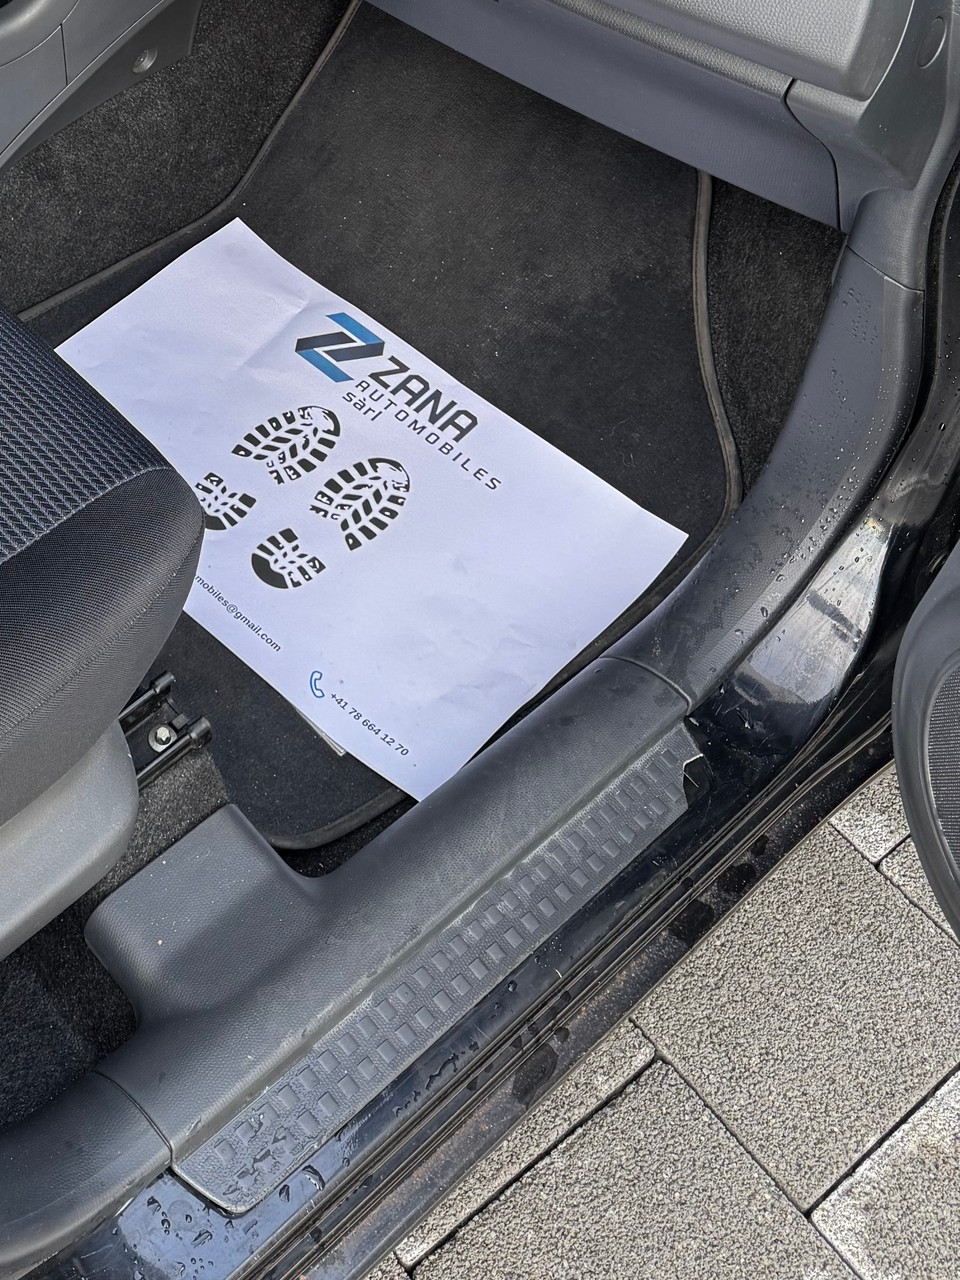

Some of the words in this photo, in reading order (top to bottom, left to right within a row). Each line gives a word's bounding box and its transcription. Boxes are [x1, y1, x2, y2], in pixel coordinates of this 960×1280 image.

[355, 380, 502, 490] AUTOMOBILES
[368, 355, 478, 443] ZANA
[330, 693, 348, 710] +41
[348, 706, 363, 721] 78
[361, 718, 381, 736] 664
[380, 733, 396, 747] 12
[394, 743, 409, 757] 70
